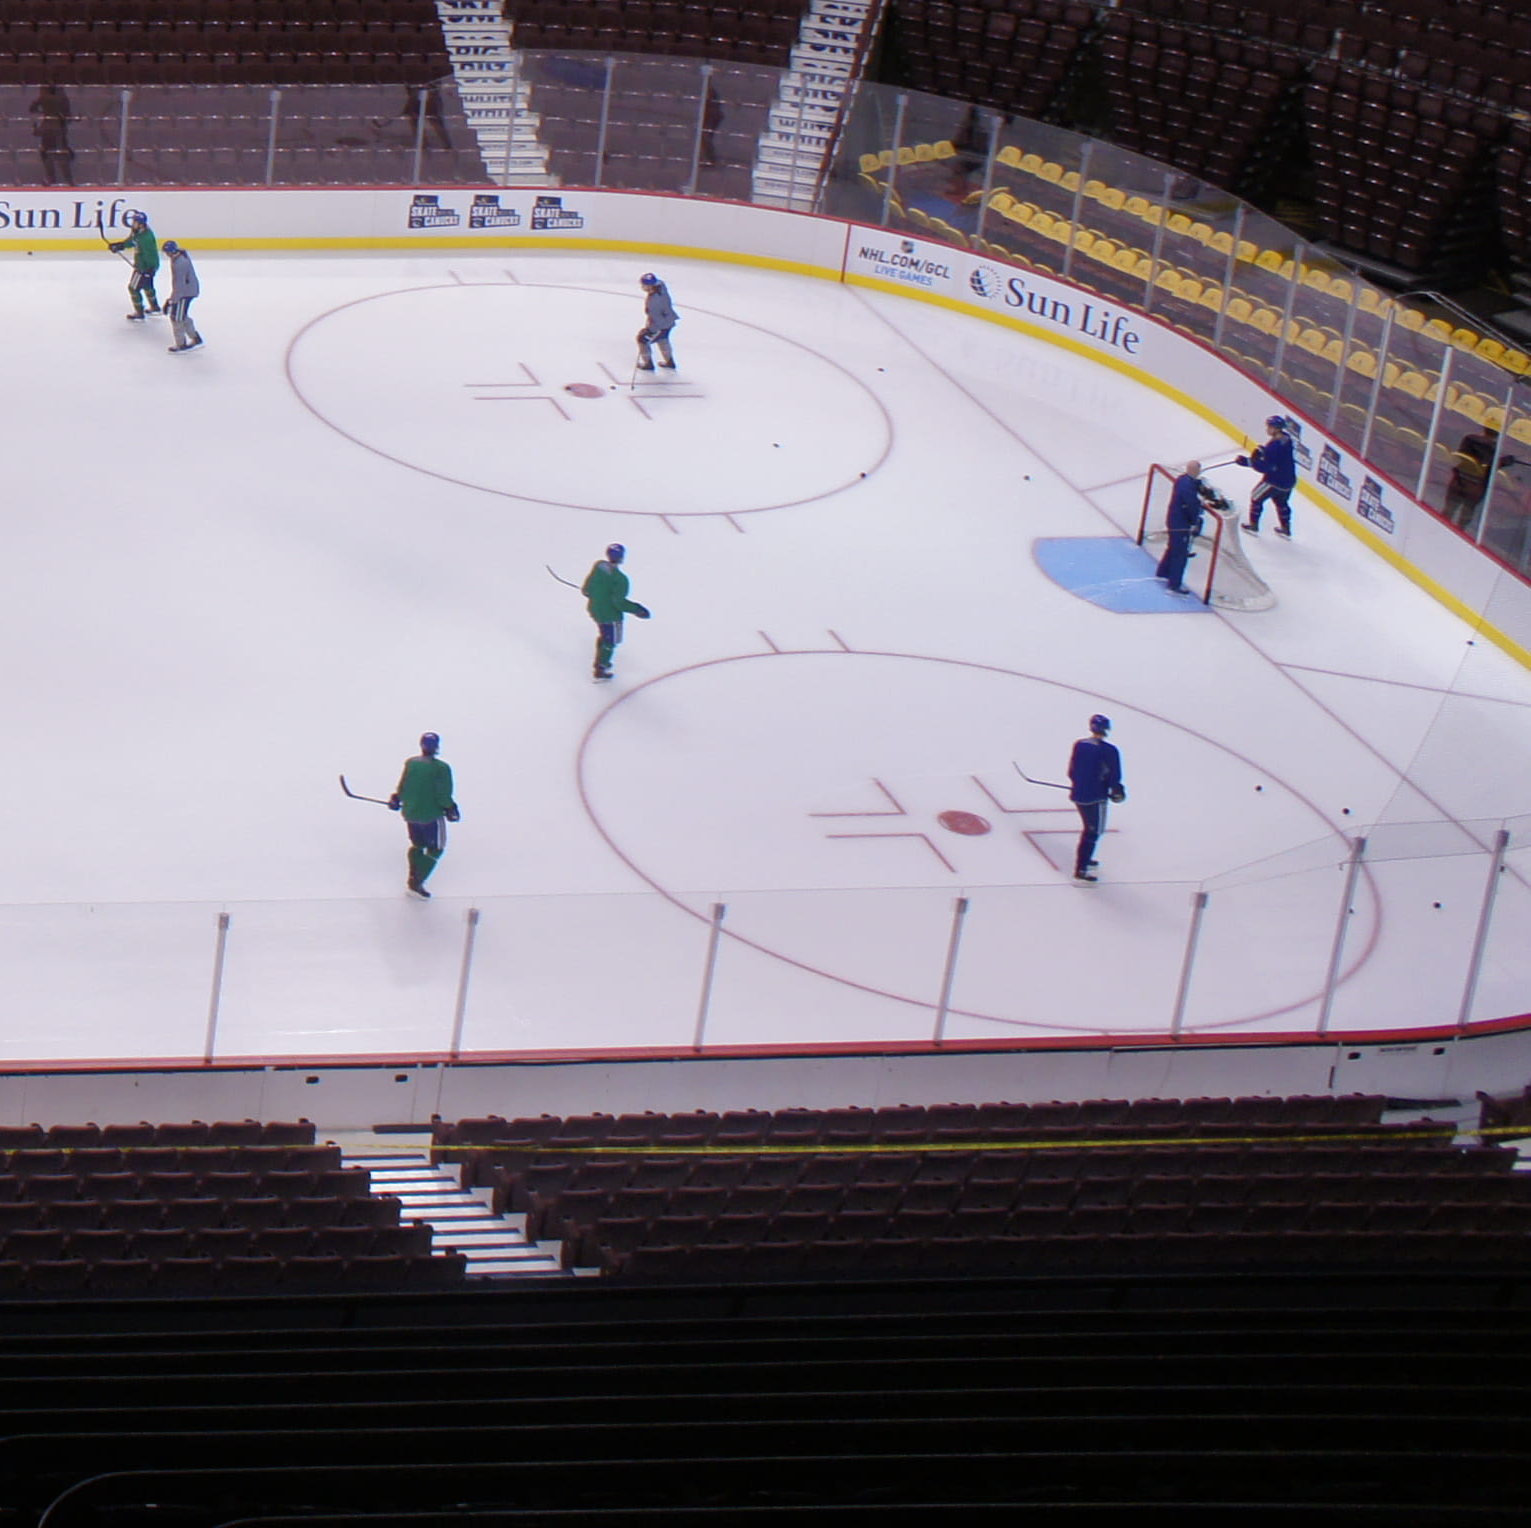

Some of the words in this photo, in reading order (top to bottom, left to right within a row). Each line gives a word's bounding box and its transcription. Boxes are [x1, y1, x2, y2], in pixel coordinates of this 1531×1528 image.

[72, 198, 139, 229] Life
[858, 246, 951, 280] NHL.COM/GCL
[874, 264, 900, 278] LIVE
[901, 269, 933, 287] GAMES
[1004, 276, 1071, 327] Sun
[1078, 302, 1140, 354] Life
